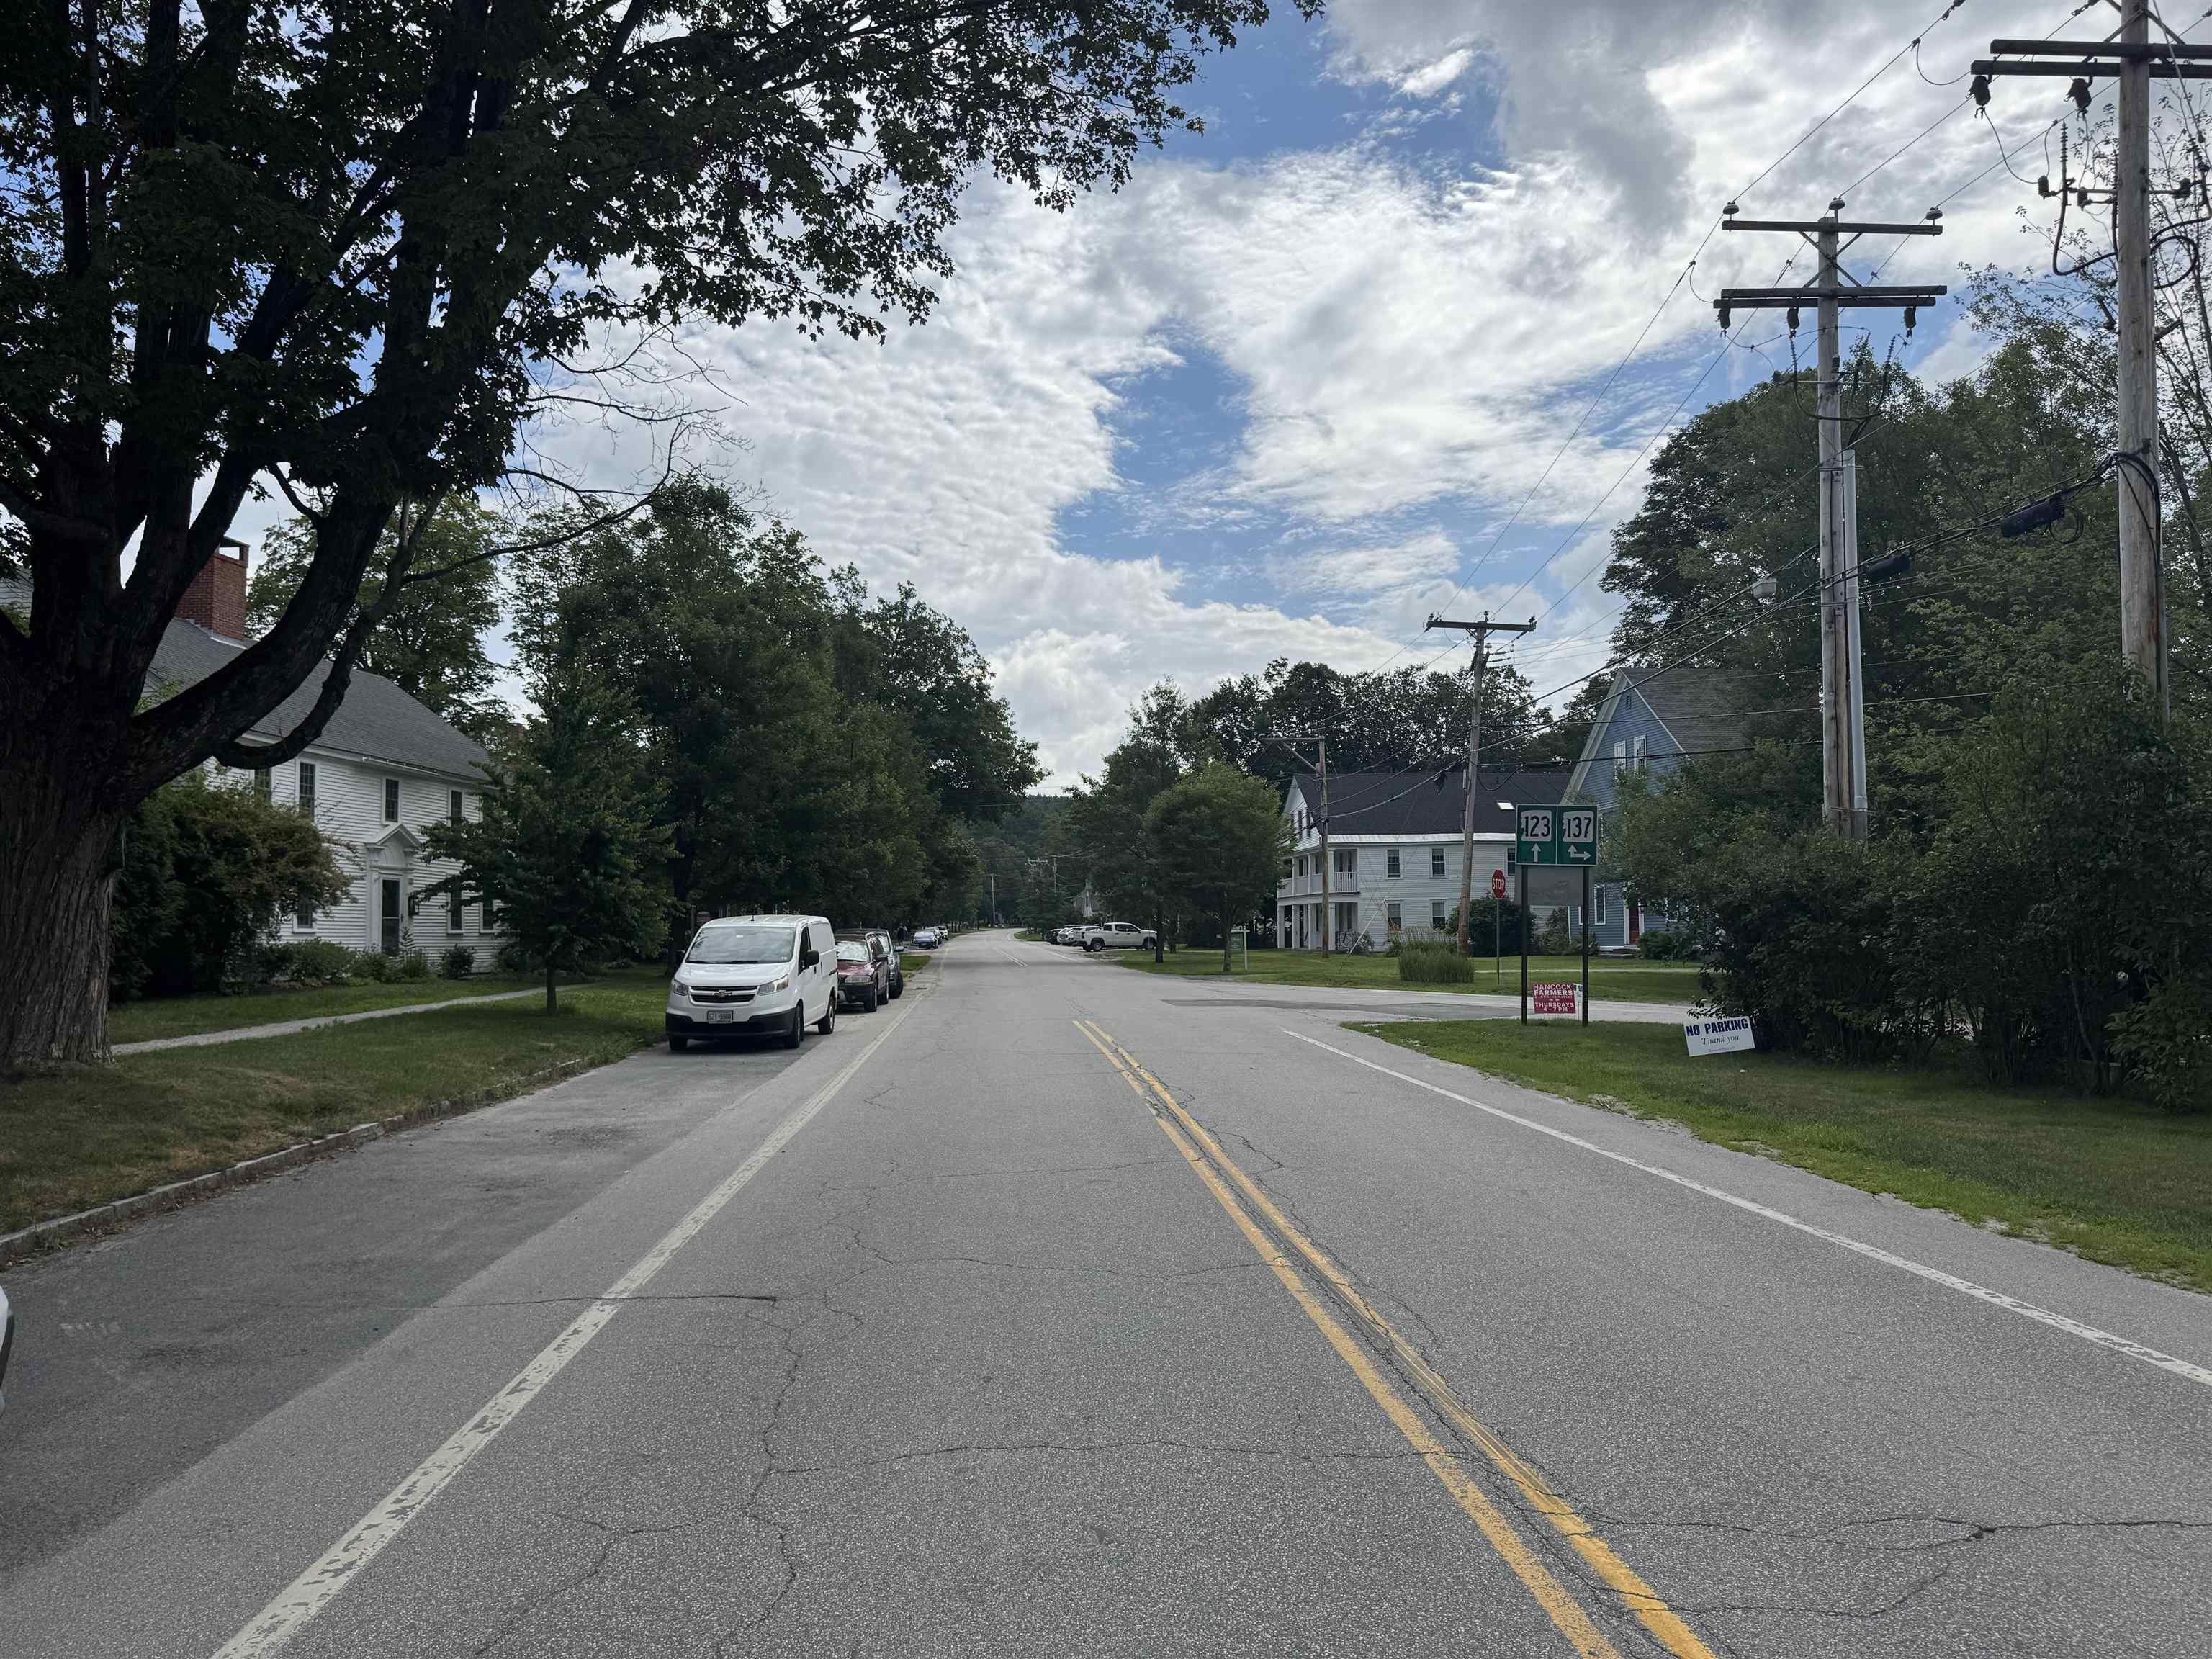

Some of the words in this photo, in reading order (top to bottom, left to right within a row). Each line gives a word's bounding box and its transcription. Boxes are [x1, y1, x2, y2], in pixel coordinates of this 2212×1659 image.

[1524, 816, 1550, 837] 123
[1567, 817, 1591, 838] 137
[1492, 878, 1505, 889] STOP
[1686, 1025, 1700, 1037] NO
[1704, 1018, 1749, 1034] PARKING
[1701, 1035, 1725, 1045] Thank
[1727, 1035, 1740, 1044] you
